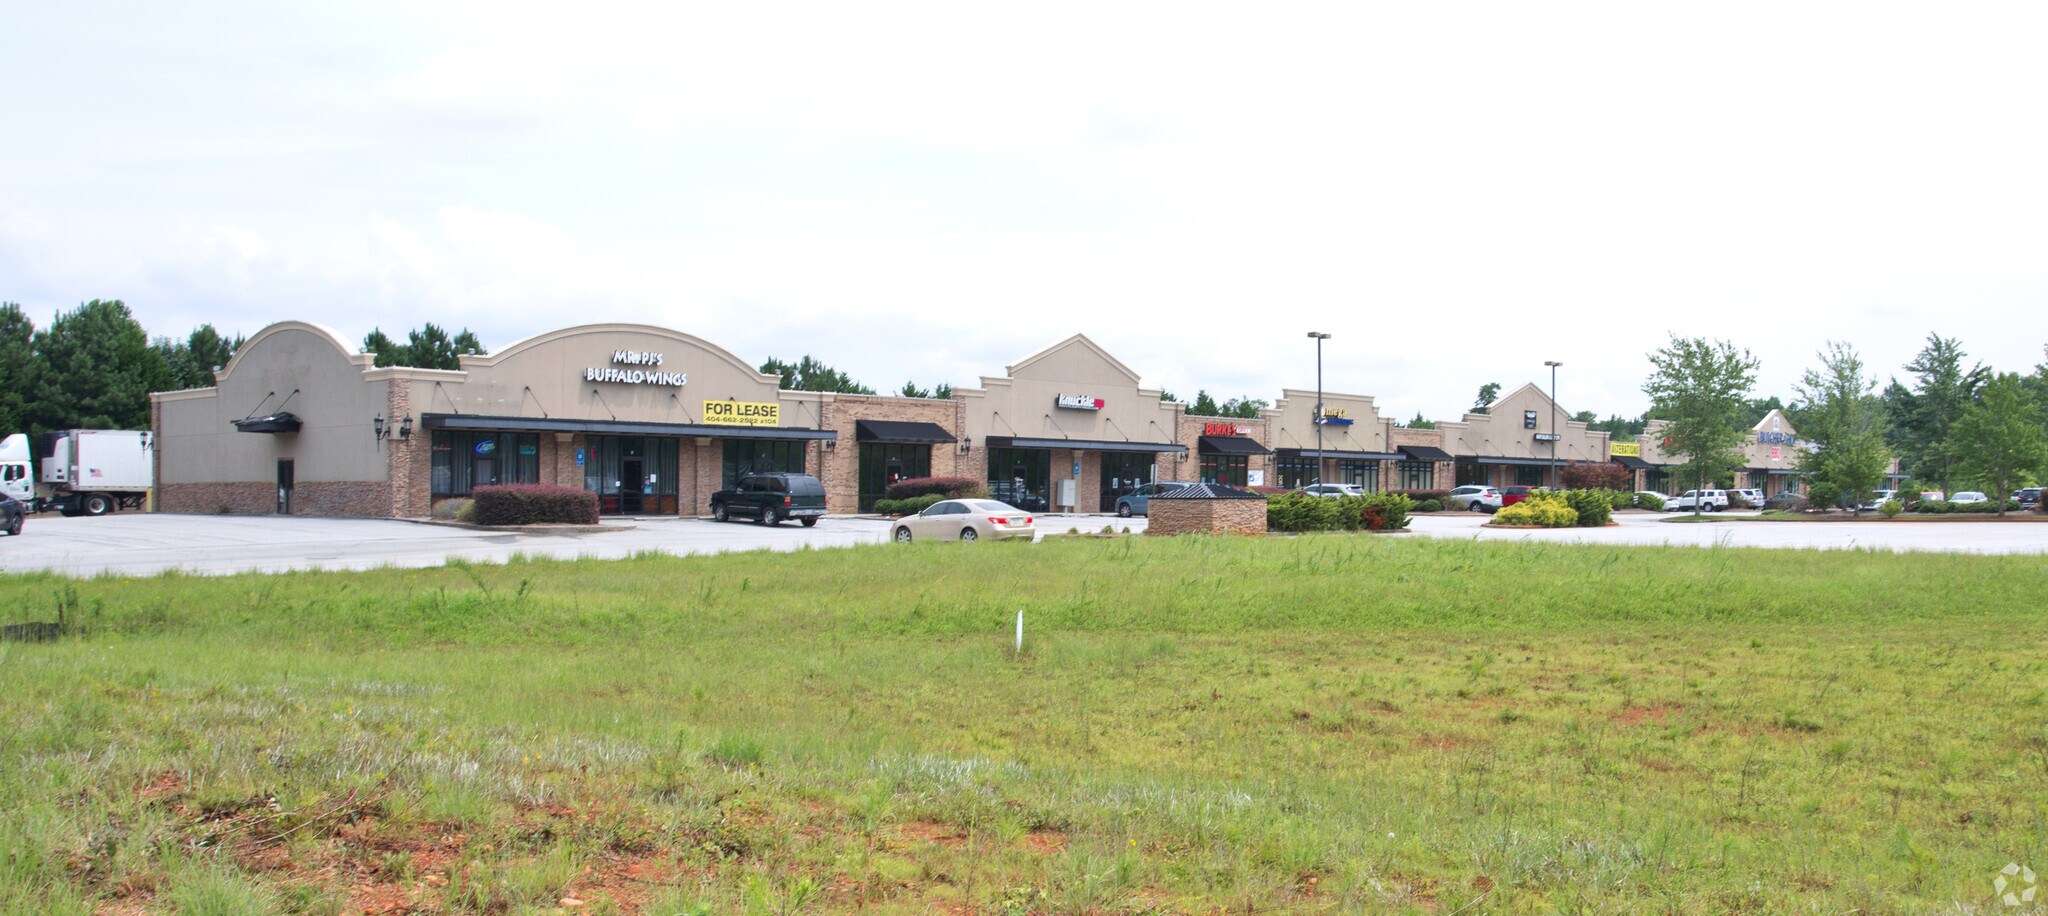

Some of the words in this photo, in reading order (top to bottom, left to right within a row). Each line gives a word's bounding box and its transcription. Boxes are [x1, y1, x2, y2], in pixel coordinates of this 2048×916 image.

[640, 351, 663, 366] PJ'S
[584, 367, 644, 384] BUFFALO
[644, 371, 687, 386] WINGS
[705, 403, 733, 416] FOR
[736, 405, 777, 418] LEASE
